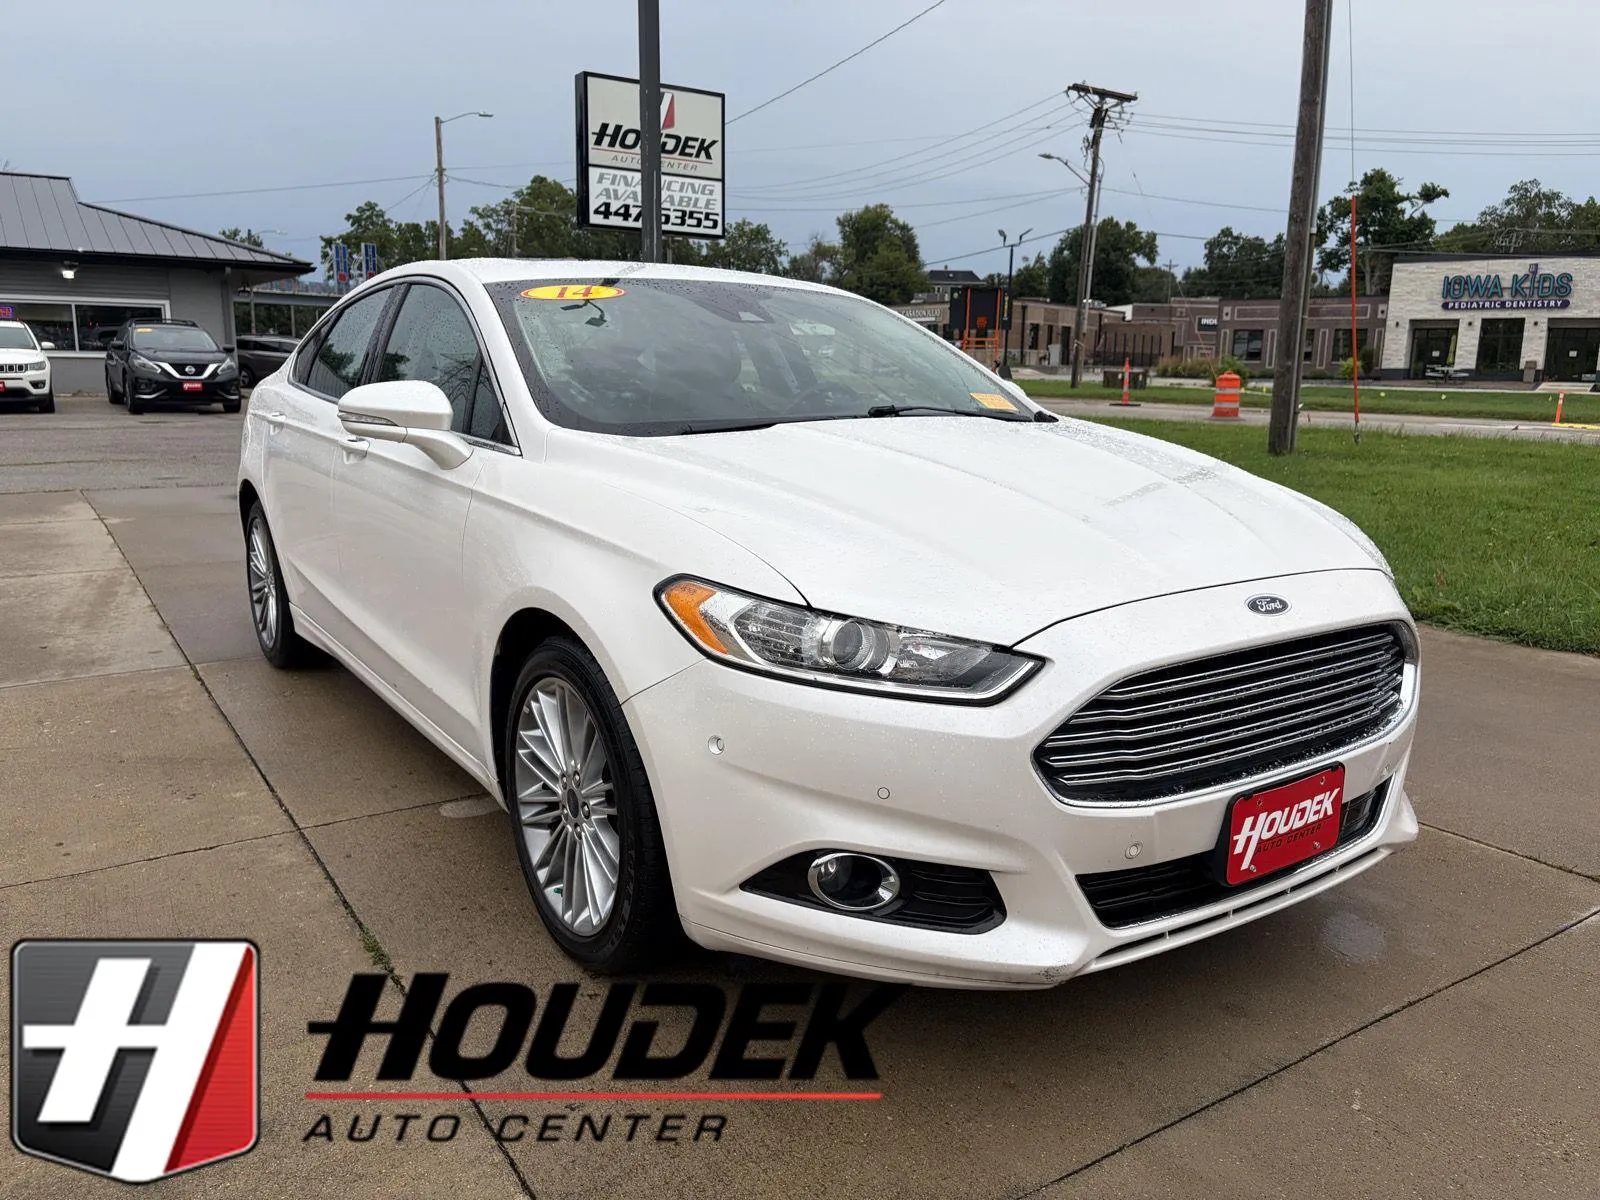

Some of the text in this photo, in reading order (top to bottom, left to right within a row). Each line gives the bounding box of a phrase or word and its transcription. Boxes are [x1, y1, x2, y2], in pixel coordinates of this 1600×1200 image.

[592, 122, 719, 160] HODEK
[595, 187, 718, 210] AVAABLE
[557, 286, 593, 298] 14
[1442, 264, 1573, 299] IOWA KIDS
[1448, 299, 1563, 310] PEDIATRIC DENTISTRY
[1256, 598, 1282, 611] Ford
[1233, 787, 1341, 871] HOUDEK
[1256, 823, 1323, 854] AUTO CENTER
